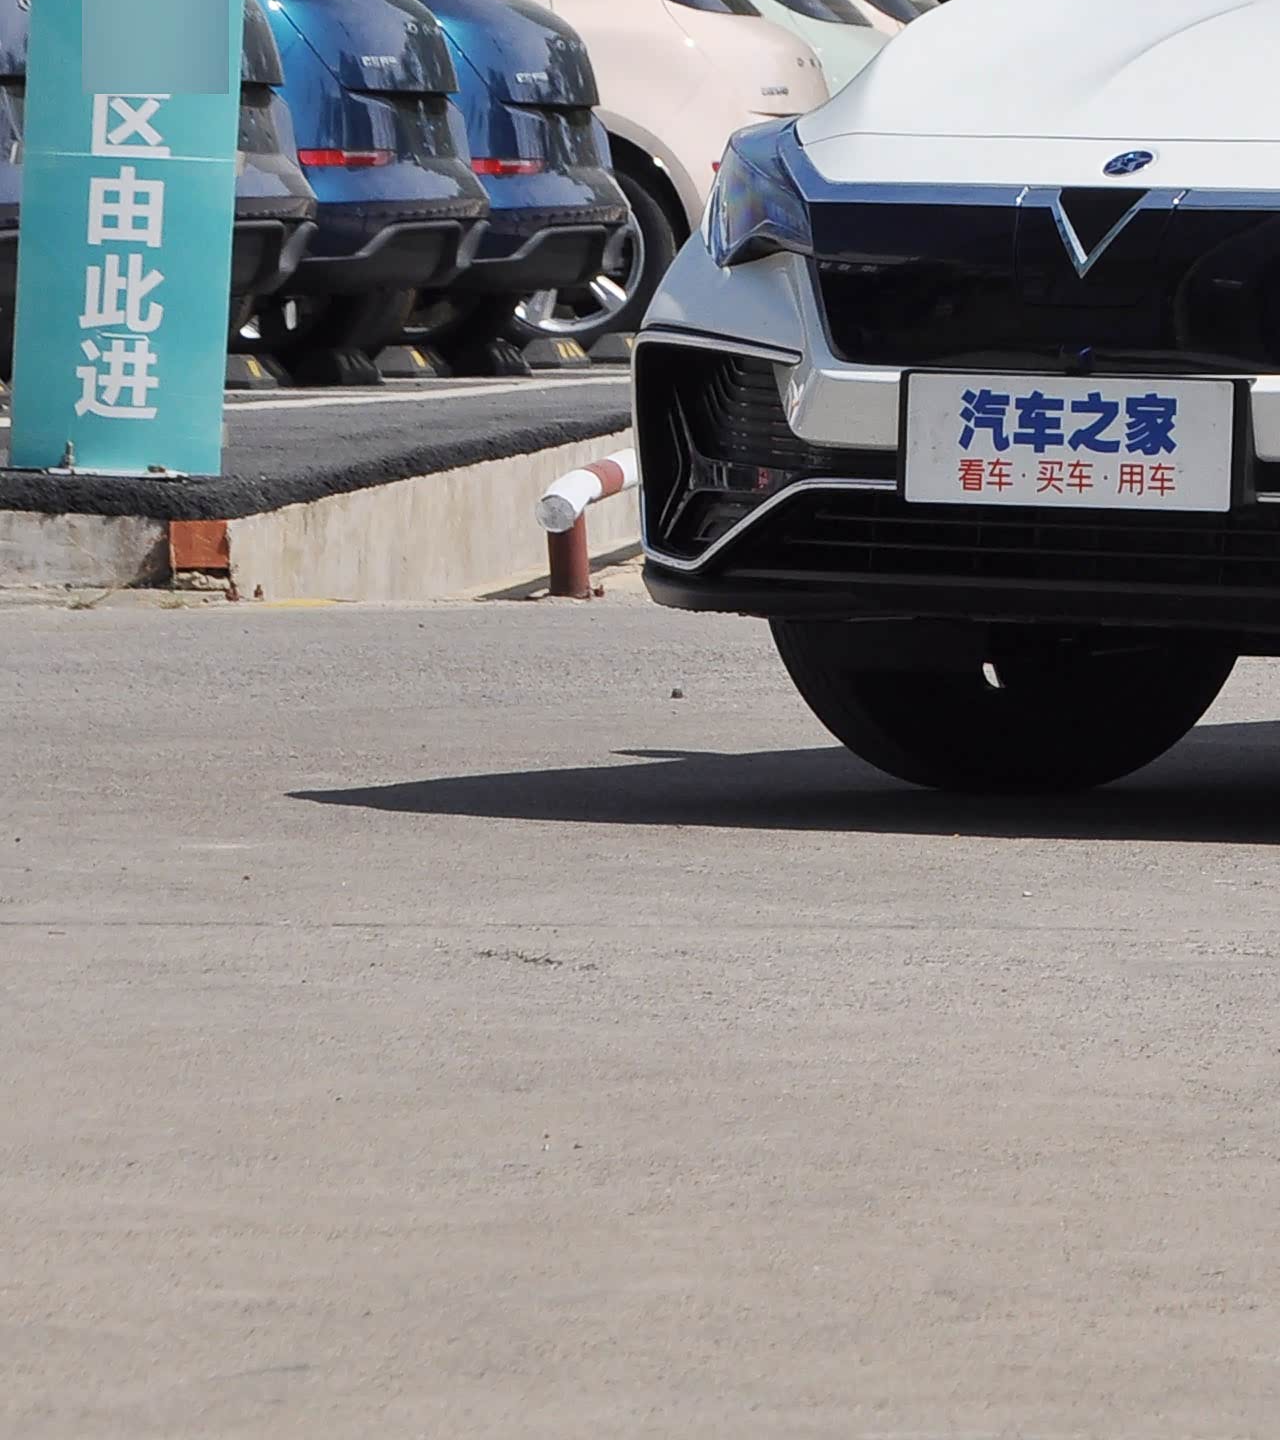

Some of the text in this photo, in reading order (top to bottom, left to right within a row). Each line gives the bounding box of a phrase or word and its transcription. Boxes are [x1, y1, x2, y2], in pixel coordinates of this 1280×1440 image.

[74, 93, 172, 420] 区由此进
[957, 388, 1178, 456] 汽车之家
